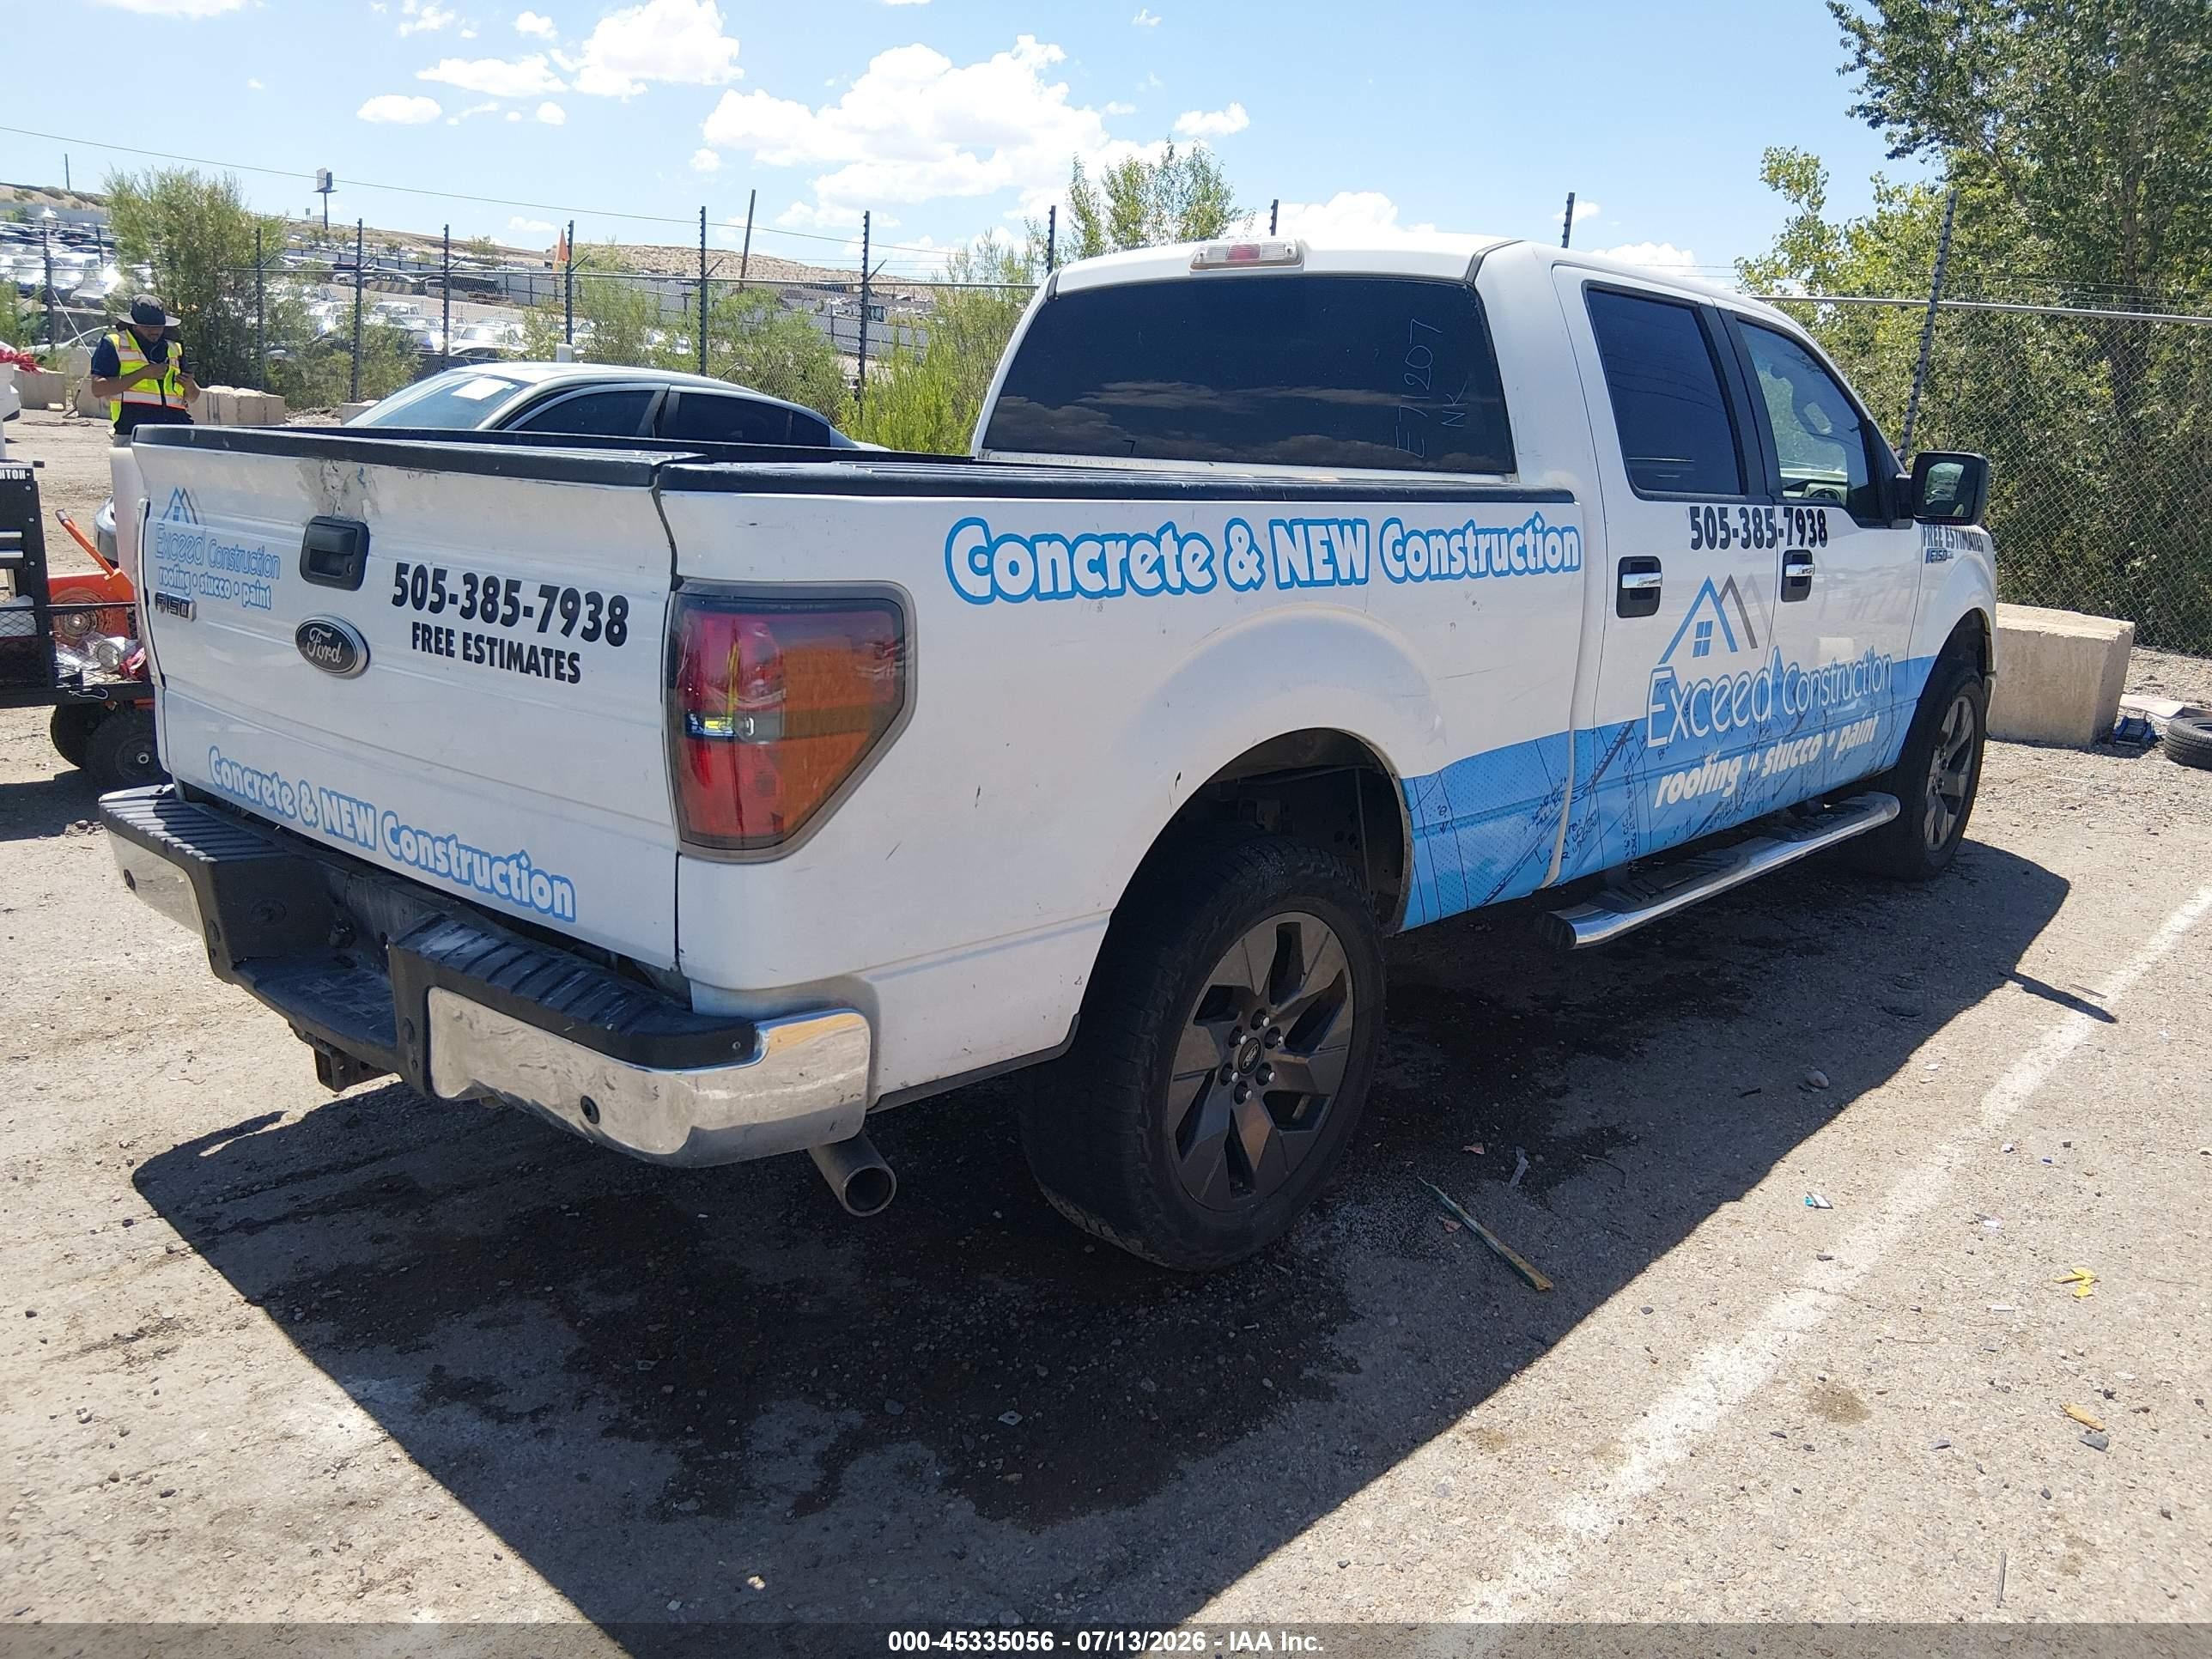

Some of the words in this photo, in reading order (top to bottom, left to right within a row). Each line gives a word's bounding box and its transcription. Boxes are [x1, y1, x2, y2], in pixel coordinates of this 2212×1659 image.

[1440, 380, 1469, 428] NK
[155, 523, 207, 566] Exceed
[208, 539, 281, 580] Construction
[1689, 505, 1828, 550] 505-385-7938
[1923, 525, 1943, 548] FREE
[1945, 526, 1984, 553] ESTIMATES
[158, 563, 191, 596] roofing
[198, 572, 232, 599] stucco
[241, 579, 272, 611] paint
[945, 515, 1218, 605] Concrete
[1224, 517, 1265, 591] &
[1270, 519, 1370, 591] NEW
[1376, 512, 1582, 585] Construction
[392, 562, 629, 647] 505-385-7938
[307, 627, 343, 665] Ford
[412, 621, 455, 659] FREE
[463, 632, 581, 684] ESTIMATES
[1647, 646, 1781, 749] Exceed
[1783, 646, 1893, 715] Construction
[1654, 749, 1743, 809] roofing
[1760, 737, 1823, 777] stucco
[1833, 710, 1880, 761] paint
[209, 745, 297, 819] Concrete
[298, 780, 318, 829] &
[319, 787, 377, 851] NEW
[380, 810, 576, 924] Construction
